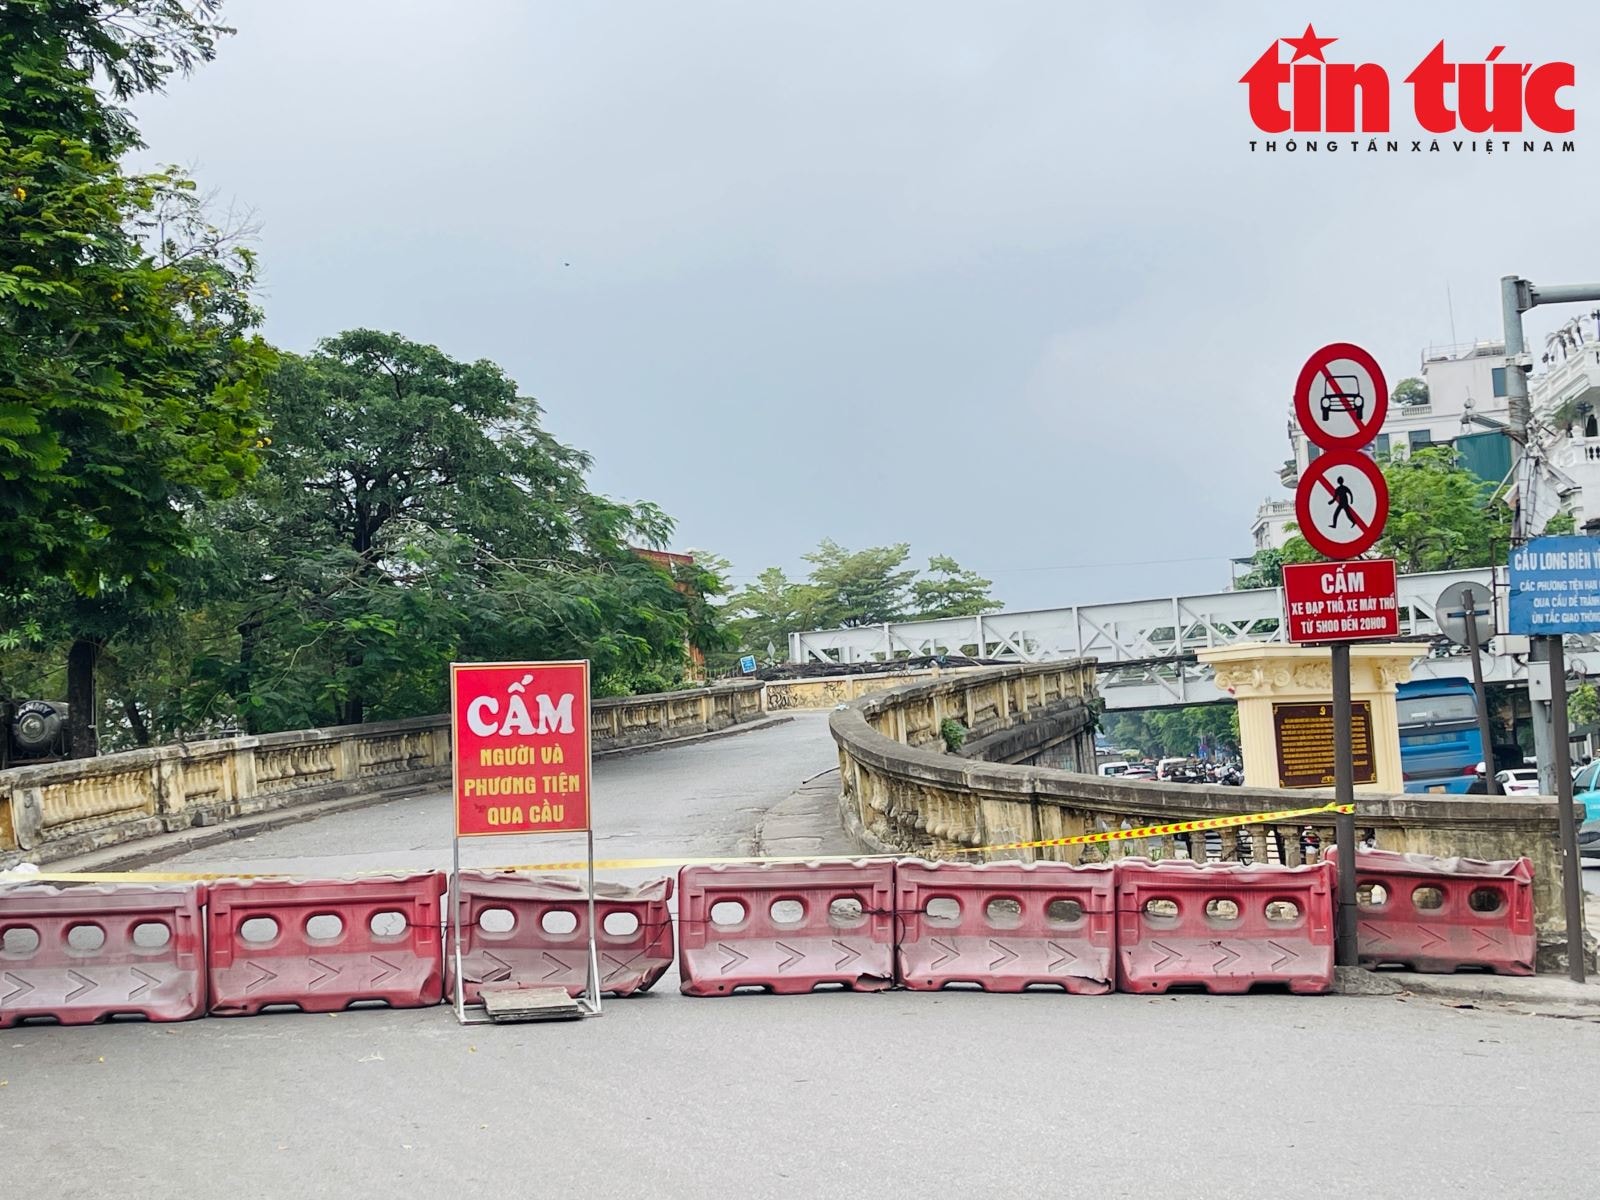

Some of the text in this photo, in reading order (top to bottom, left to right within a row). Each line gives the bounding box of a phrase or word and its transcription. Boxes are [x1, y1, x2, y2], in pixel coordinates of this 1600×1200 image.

[1540, 552, 1567, 570] LONG
[1568, 549, 1591, 570] BIÊN
[1321, 564, 1365, 594] CẤM
[1291, 602, 1304, 616] XE
[1347, 599, 1358, 612] XE
[1360, 596, 1377, 611] MÁY
[1533, 597, 1550, 608] QUA
[1300, 618, 1313, 634] TỪ
[1316, 619, 1339, 633] 5H00
[1360, 616, 1387, 631] 20H00
[467, 674, 575, 737] CẤM
[480, 743, 564, 766] NGƯỜI VÀ
[464, 772, 580, 797] PHƯƠNG TIỆN
[487, 799, 564, 825] QUA CẦU
